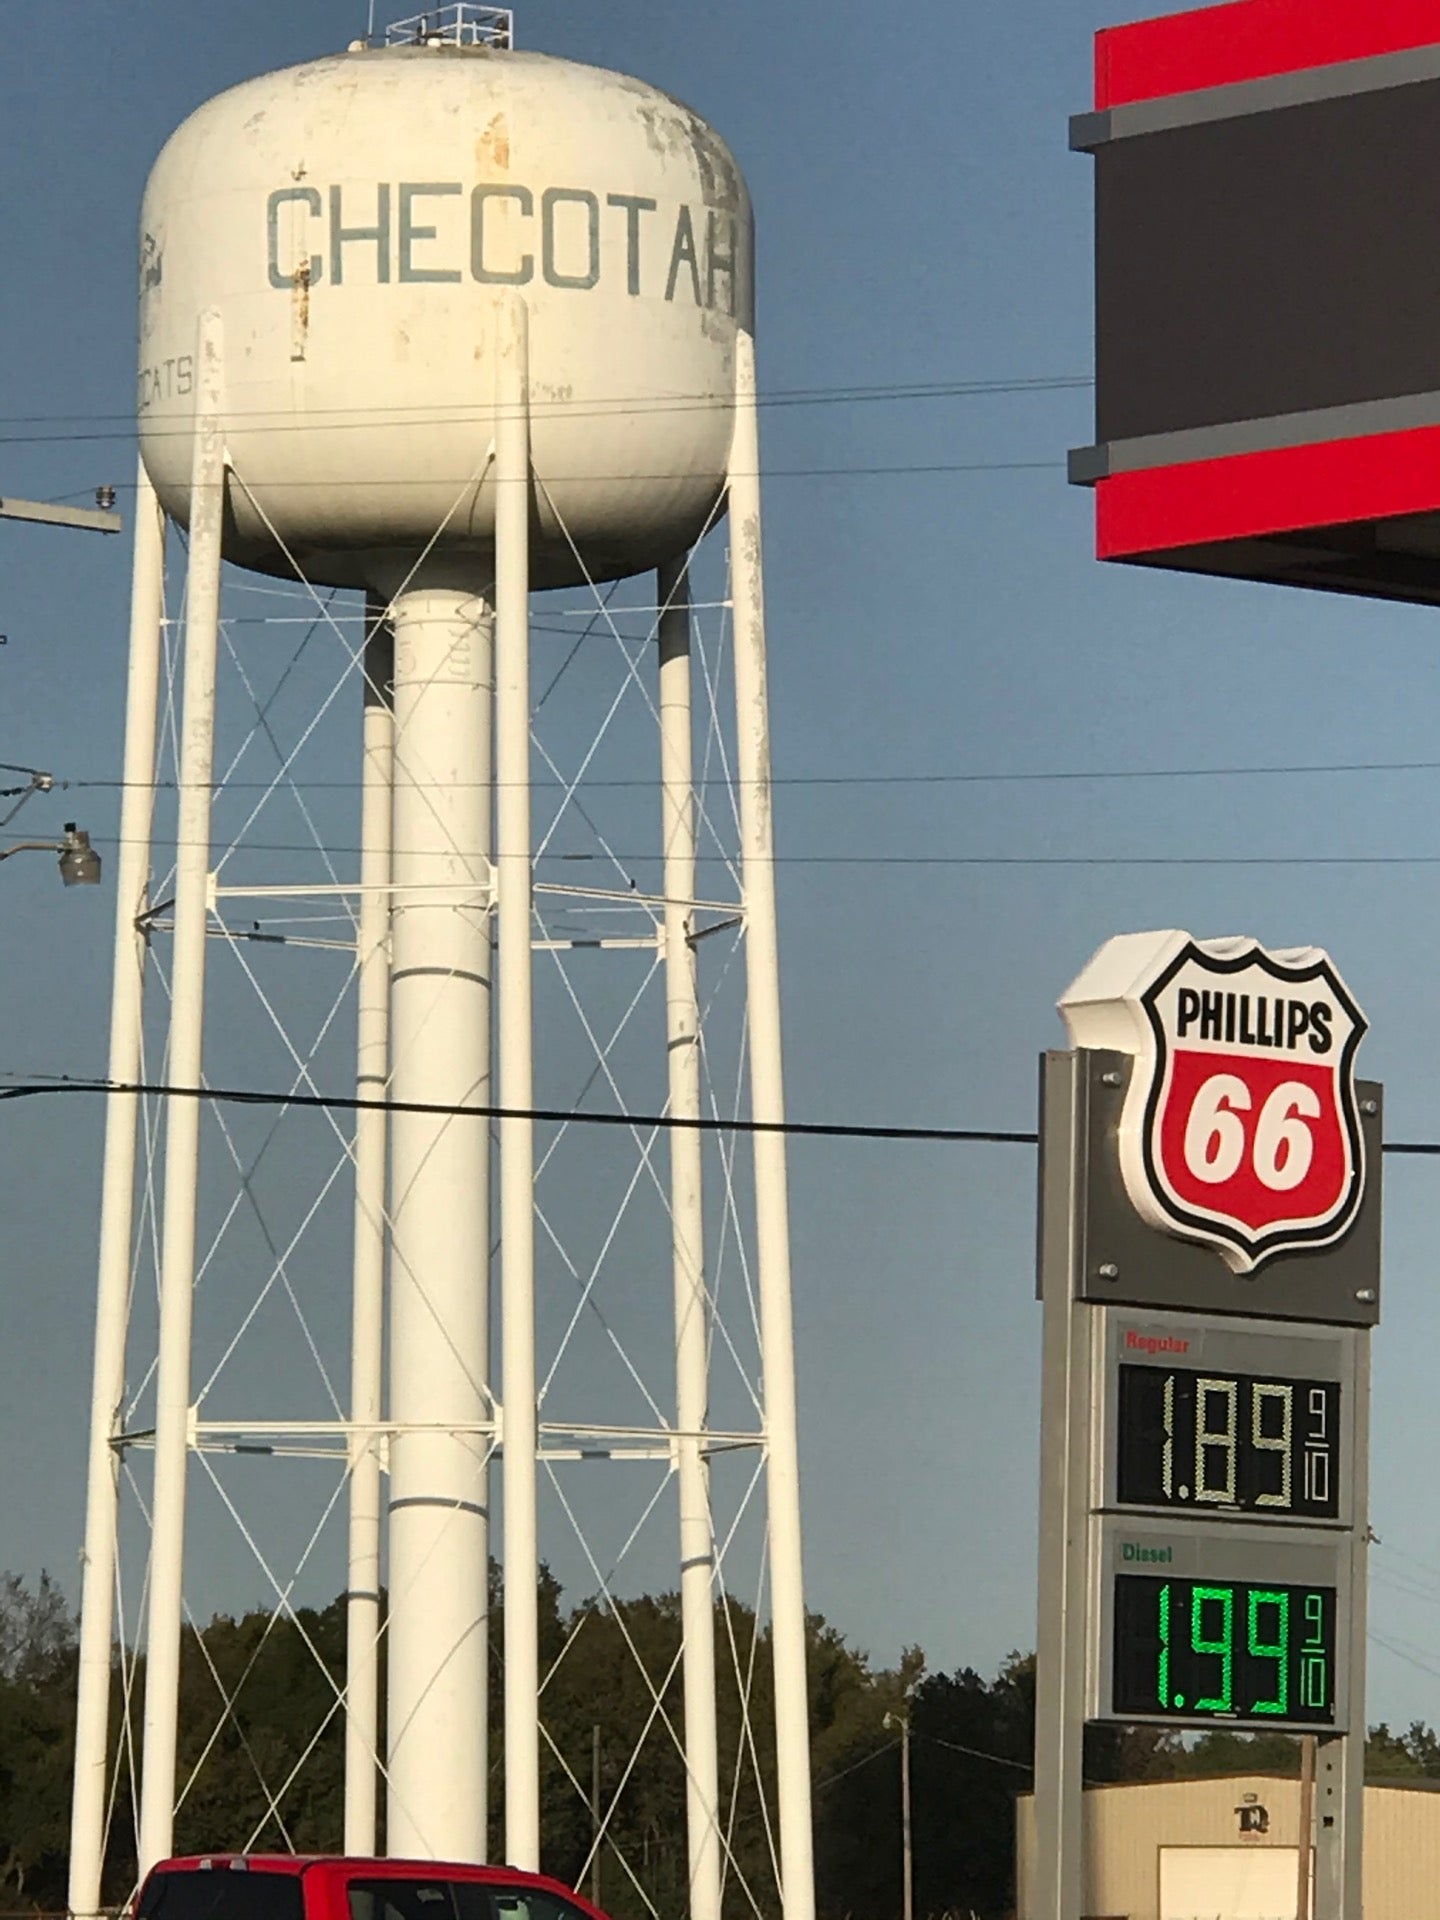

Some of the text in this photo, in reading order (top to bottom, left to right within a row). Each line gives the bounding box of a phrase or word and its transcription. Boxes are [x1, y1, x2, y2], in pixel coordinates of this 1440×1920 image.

[267, 182, 735, 317] CHECOTAH
[1177, 987, 1333, 1055] PHILLIPS
[1184, 1073, 1322, 1192] 66
[1126, 1331, 1190, 1354] Regular
[1122, 1542, 1172, 1563] Diesel
